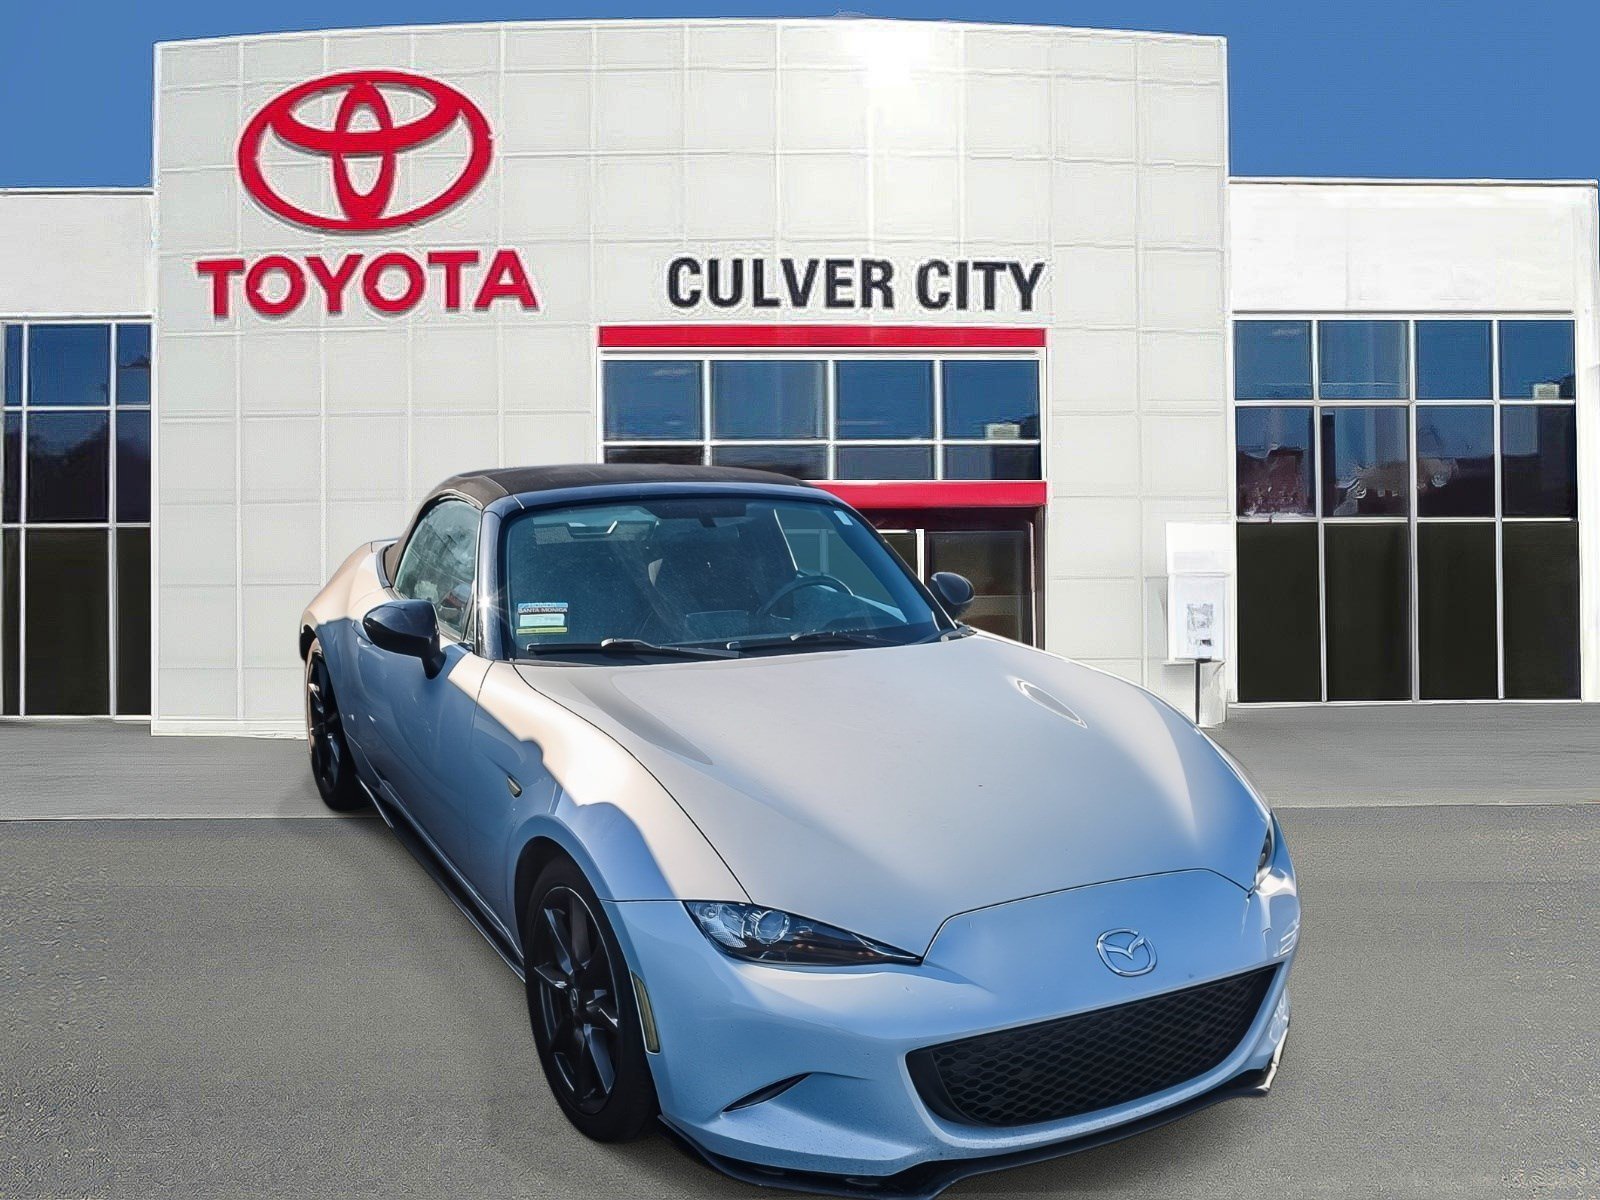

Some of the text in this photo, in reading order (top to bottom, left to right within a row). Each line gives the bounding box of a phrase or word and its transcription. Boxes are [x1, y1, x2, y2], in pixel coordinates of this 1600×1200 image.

[196, 250, 538, 318] TOYOTA
[667, 257, 1046, 311] CULVER CITY
